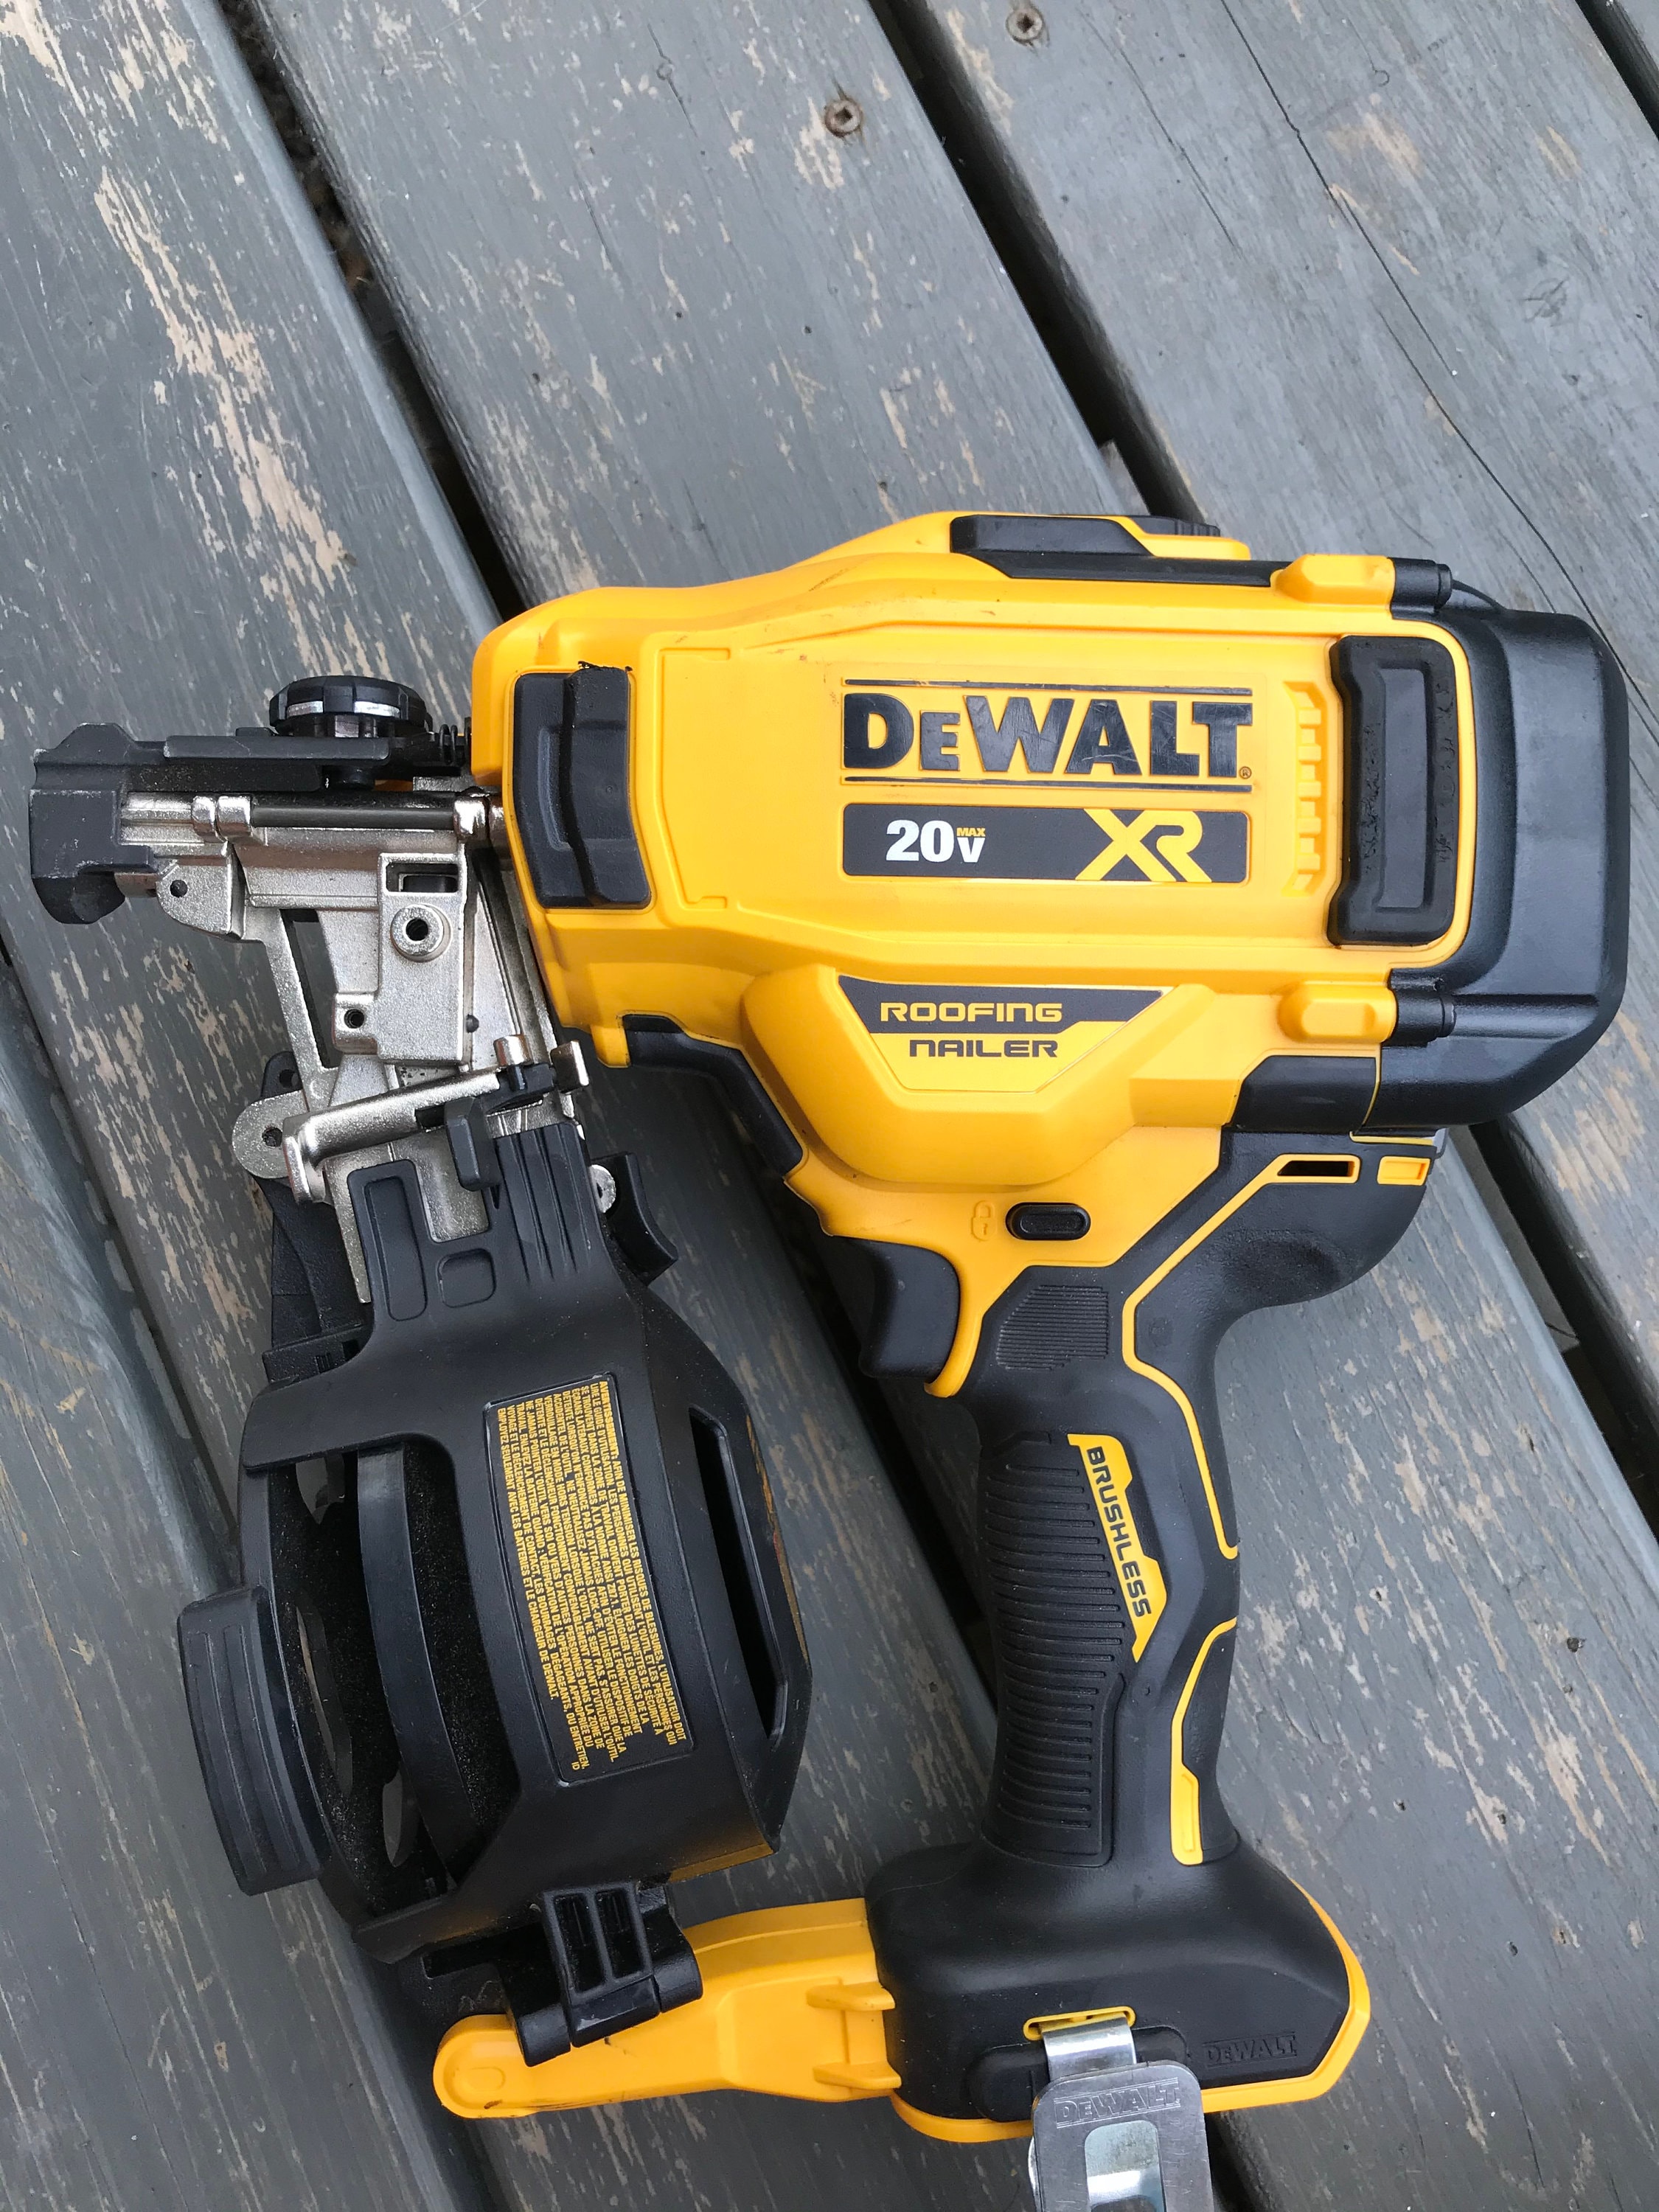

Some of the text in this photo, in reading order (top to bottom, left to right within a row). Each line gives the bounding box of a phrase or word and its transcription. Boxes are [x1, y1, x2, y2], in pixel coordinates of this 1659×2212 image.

[956, 827, 986, 837] MAX
[1075, 808, 1211, 883] XR
[880, 1002, 1062, 1022] ROOFING
[909, 1039, 1058, 1058] NAILER
[580, 1385, 589, 1395] SE
[590, 1382, 599, 1398] LIRE
[524, 1399, 533, 1411] NE
[591, 1397, 600, 1407] LE
[506, 1405, 516, 1433] VOYAGE
[543, 1394, 557, 1446] VERROUILLAGE
[552, 1392, 566, 1435] ACCIDENTEL
[582, 1394, 594, 1432] TROUVENT
[593, 1406, 604, 1429] GUIDE
[497, 1408, 508, 1444] EMPLOYEZ
[526, 1410, 537, 1439] JAMAIS
[538, 1427, 546, 1438] ET
[509, 1432, 518, 1442] ET
[510, 1442, 519, 1453] LE
[539, 1438, 548, 1447] LE
[558, 1434, 567, 1446] DE
[587, 1431, 598, 1455] DANS
[518, 1433, 531, 1466] ENLEVEZ
[529, 1439, 541, 1472] POINTER
[549, 1446, 559, 1458] EN
[501, 1444, 515, 1490] SEULEMENT
[552, 1458, 563, 1483] MODE
[591, 1455, 600, 1467] LA
[611, 1459, 623, 1480] AFIN
[523, 1466, 532, 1478] LA
[580, 1453, 597, 1505] CONFORMES
[593, 1466, 605, 1489] ZONE
[555, 1483, 568, 1507] HORS
[565, 1479, 575, 1492] NE
[597, 1489, 607, 1502] DE
[607, 1488, 618, 1504] LES
[616, 1480, 625, 1492] DE
[507, 1490, 518, 1513] AVEC
[524, 1477, 539, 1517] BATTERIE
[510, 1512, 521, 1529] LES
[539, 1502, 551, 1526] VERS
[567, 1492, 586, 1550] NEUTRALISEZ
[580, 1511, 592, 1529] PAS
[591, 1513, 602, 1526] LA
[599, 1501, 614, 1539] TRAVAIL
[618, 1492, 636, 1542] MINIMISER
[522, 1521, 532, 1534] DE
[531, 1516, 545, 1548] QUAND
[543, 1526, 554, 1542] SOI
[560, 1506, 575, 1546] TENSION
[610, 1504, 629, 1557] PERSONNES
[1087, 1446, 1152, 1617] BRUSHLESS
[546, 1542, 556, 1556] OU
[549, 1505, 570, 1572] FONCTIONNENT
[594, 1526, 608, 1559] NORME
[513, 1529, 529, 1576] BATTERIES
[607, 1539, 623, 1578] DOIVENT
[627, 1541, 639, 1559] LES
[549, 1556, 561, 1580] VERS
[567, 1546, 583, 1587] LORSQUE
[578, 1549, 594, 1586] JAMAIS
[601, 1559, 613, 1582] ANSI
[621, 1557, 633, 1575] QUI
[522, 1576, 532, 1589] ET
[532, 1577, 543, 1595] LES
[631, 1558, 648, 1597] RISQUES
[524, 1589, 535, 1600] LE
[596, 1585, 608, 1607] AFIN
[615, 1578, 631, 1613] PORTER
[625, 1575, 643, 1621] UTILISENT
[640, 1598, 651, 1611] DE
[527, 1601, 546, 1649] CHARGEUR
[536, 1595, 556, 1649] BOURRAGES
[551, 1613, 561, 1627] DE
[562, 1572, 590, 1658] CONVENABLEMENT
[623, 1613, 636, 1632] DES
[583, 1621, 594, 1635] NE
[538, 1649, 549, 1662] DE
[563, 1624, 584, 1677] PERSONNES
[587, 1635, 600, 1658] SERT
[596, 1630, 613, 1669] UTILISER
[611, 1646, 621, 1658] LE
[627, 1632, 647, 1676] LUNETTES
[622, 1652, 634, 1668] LES
[644, 1654, 655, 1666] ET
[582, 1657, 597, 1688] AVANT
[606, 1669, 616, 1680] LE
[639, 1676, 650, 1688] DE
[647, 1666, 658, 1682] LES
[577, 1678, 591, 1703] DANS
[627, 1668, 643, 1700] DOIGTS
[608, 1680, 629, 1725] DISPOSITIF
[613, 1658, 641, 1733] FONCTIONNEMENT
[635, 1700, 646, 1712] DE
[583, 1703, 594, 1715] LA
[651, 1682, 672, 1731] PERSONNES
[565, 1712, 576, 1725] OU
[587, 1715, 601, 1737] ZONE
[639, 1712, 650, 1724] LA
[582, 1735, 594, 1747] DU
[611, 1725, 623, 1742] QUE
[622, 1725, 632, 1736] DE
[665, 1731, 677, 1745] QUI
[672, 1722, 686, 1740] DOIT
[594, 1737, 605, 1749] DE
[616, 1742, 627, 1753] LA
[569, 1761, 580, 1770] ID
[1204, 2034, 1298, 2064] DEWALT
[1054, 2084, 1180, 2124] DEWALT
